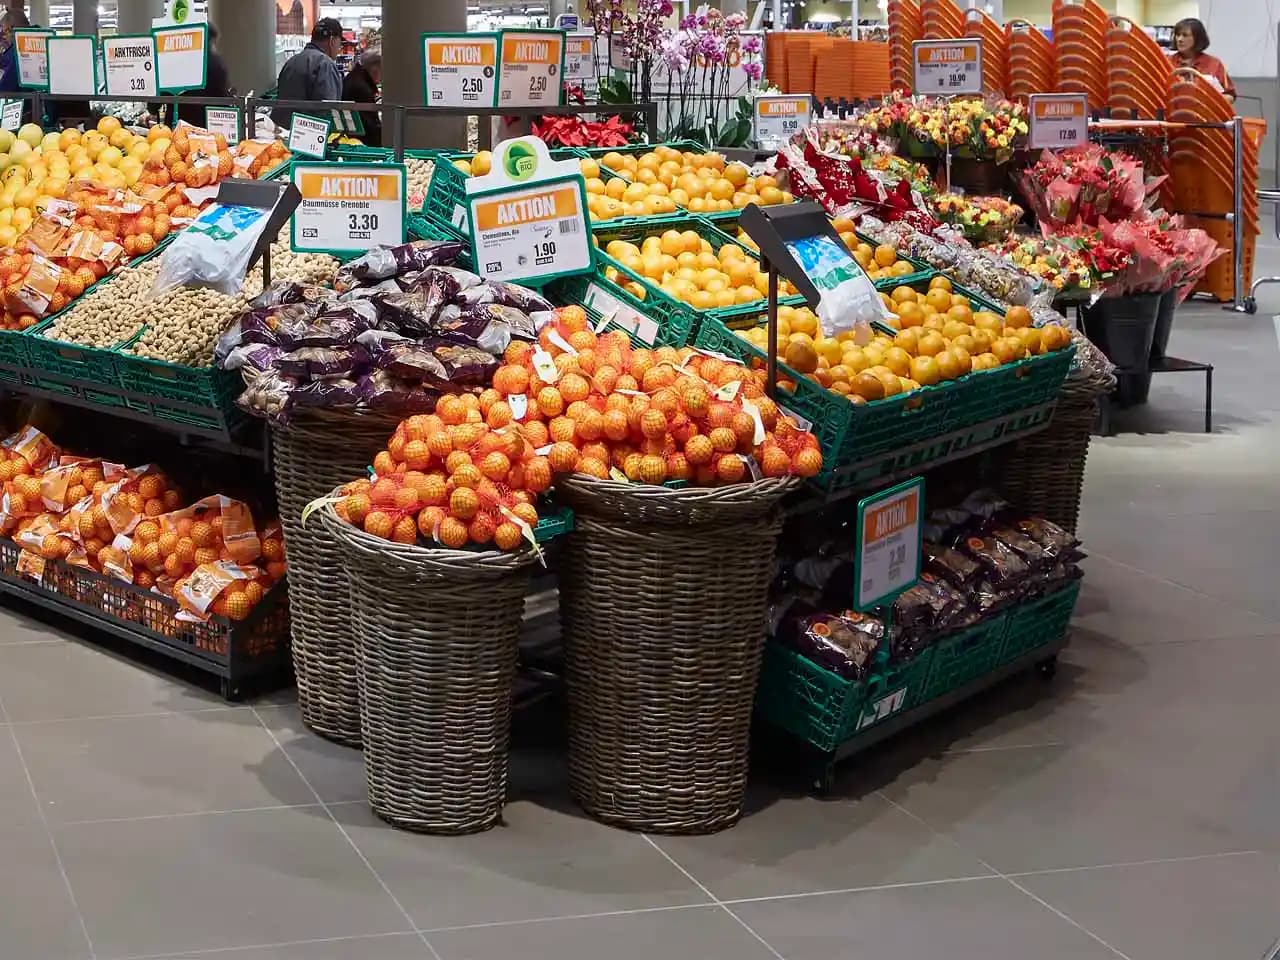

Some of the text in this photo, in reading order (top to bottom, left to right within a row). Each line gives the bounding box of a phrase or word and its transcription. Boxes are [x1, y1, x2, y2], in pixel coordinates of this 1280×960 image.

[163, 35, 192, 50] AKTION
[108, 45, 151, 58] MARKTFRISCH
[442, 46, 481, 64] AKTION
[514, 42, 548, 61] AKTION
[929, 47, 965, 61] AKTION
[131, 78, 145, 90] 3.20
[462, 78, 483, 93] 2.50
[529, 76, 547, 91] 2.50
[768, 102, 796, 113] AKTION
[520, 163, 532, 171] BIO
[320, 175, 378, 197] AKTION
[303, 199, 369, 208] Baumnüsse Grenoble
[497, 194, 556, 224] AKTION
[349, 214, 378, 230] 3.30
[534, 241, 556, 257] 1.90
[875, 500, 908, 538] AKTION
